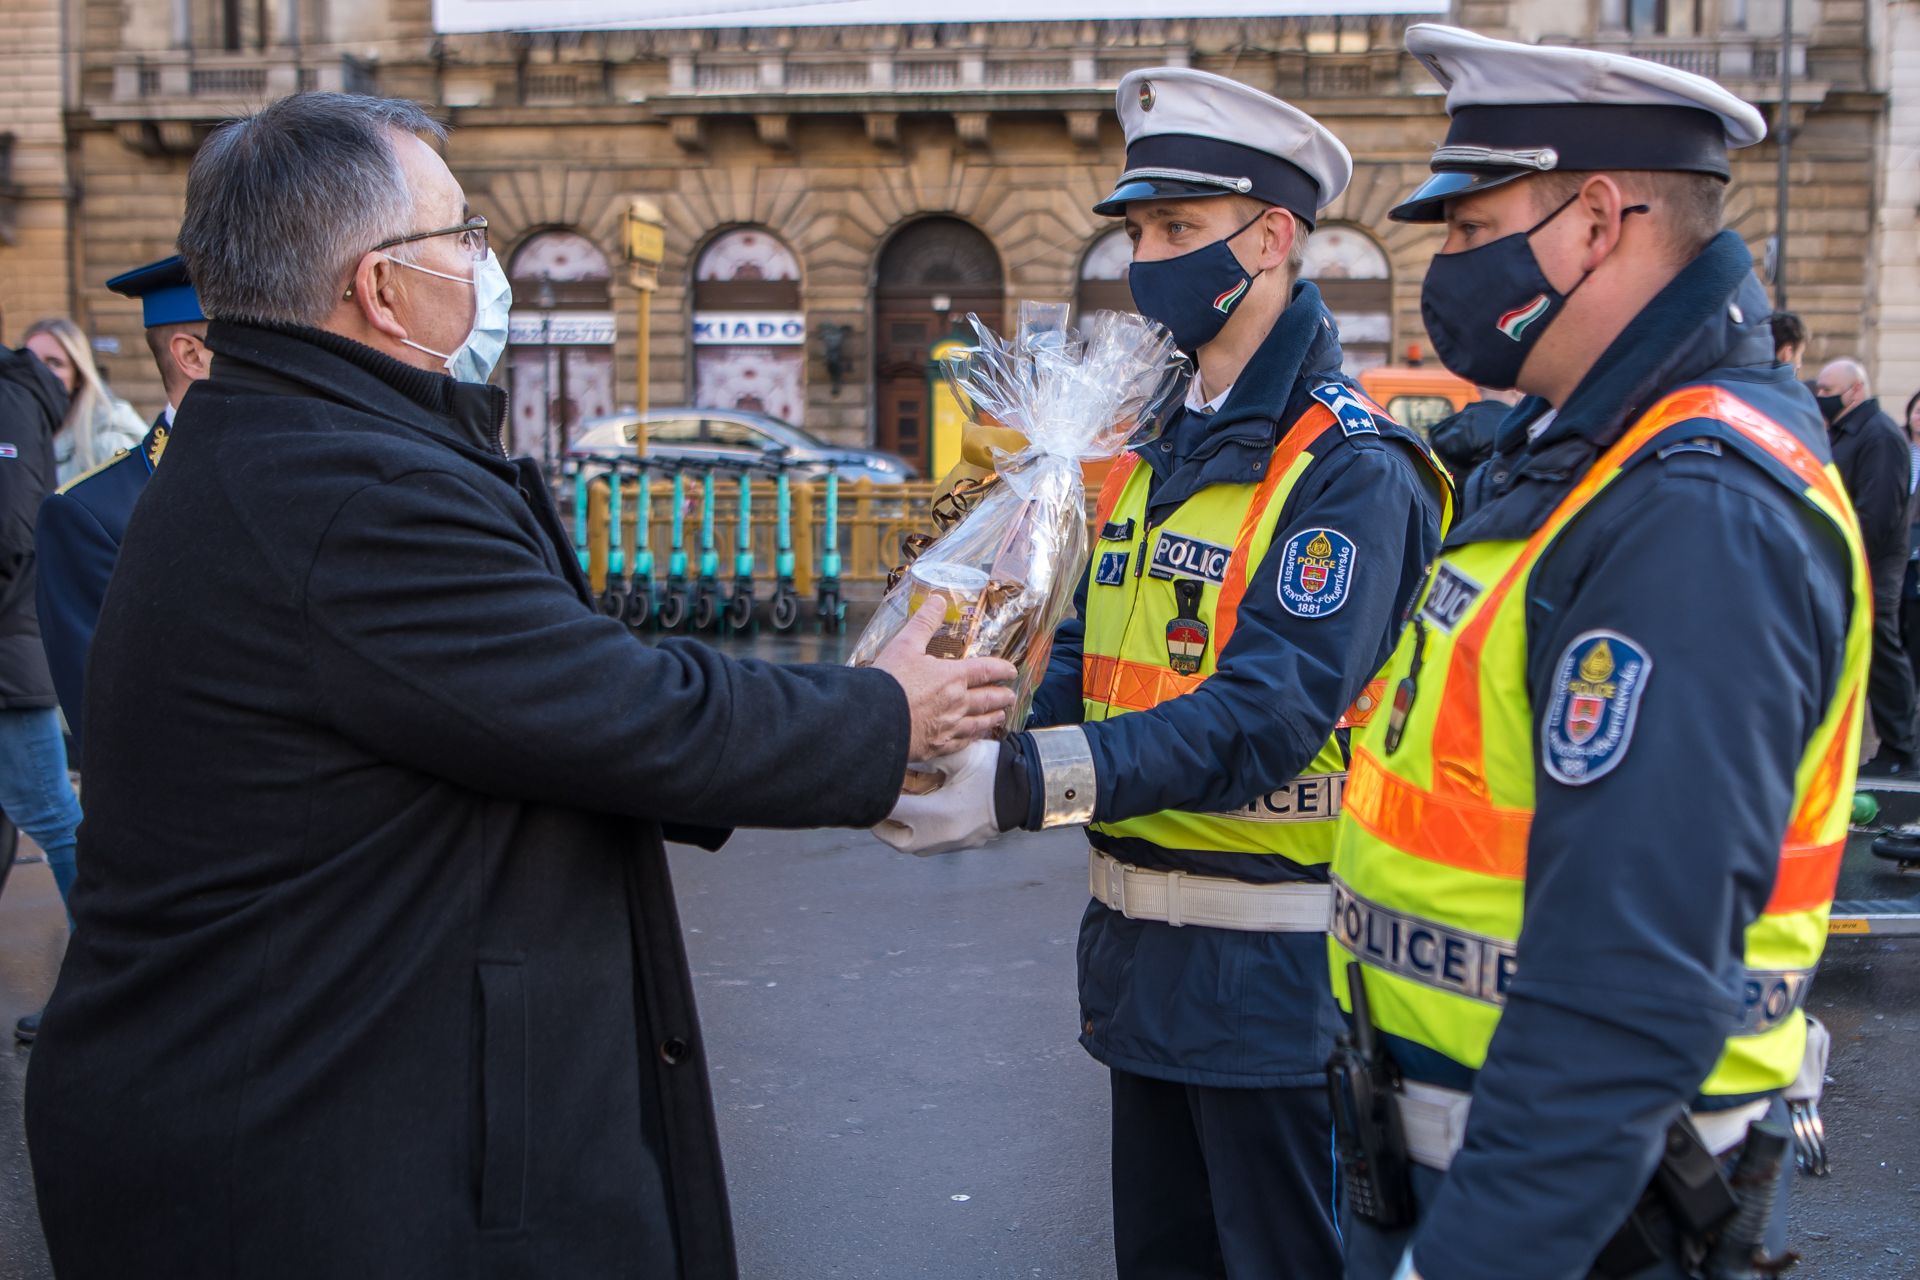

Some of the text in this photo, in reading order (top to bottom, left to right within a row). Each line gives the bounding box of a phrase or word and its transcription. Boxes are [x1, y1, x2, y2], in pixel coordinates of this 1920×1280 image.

[694, 320, 803, 337] KIADÓ
[1284, 541, 1299, 582] BUDAPESTI
[1297, 556, 1336, 569] POLICE
[1297, 603, 1320, 614] 1881
[1428, 574, 1472, 624] OLIC
[1335, 888, 1466, 984] POLICE
